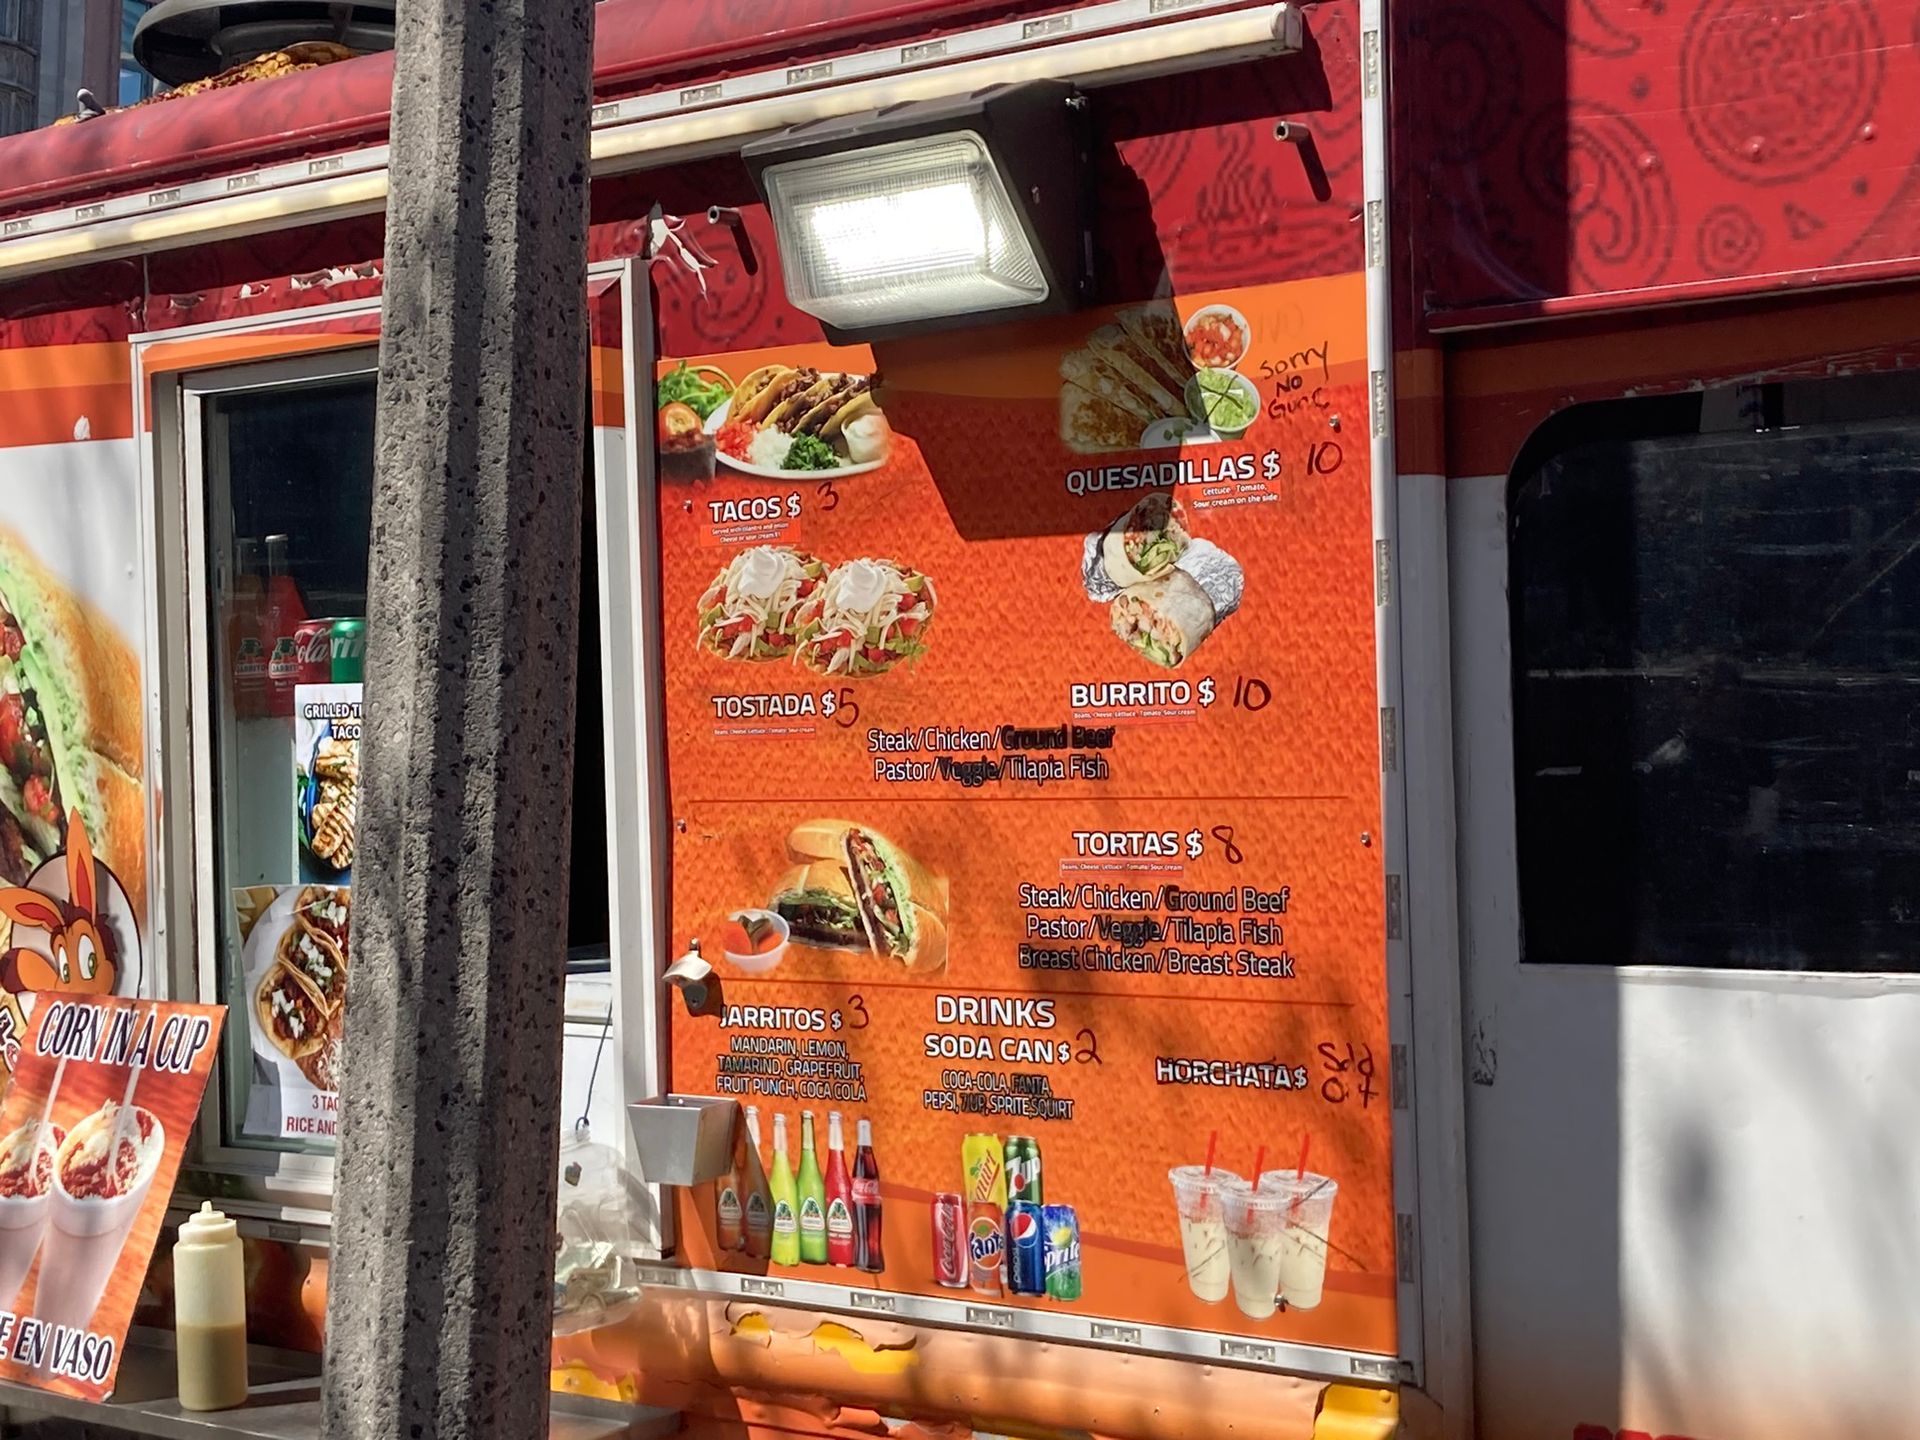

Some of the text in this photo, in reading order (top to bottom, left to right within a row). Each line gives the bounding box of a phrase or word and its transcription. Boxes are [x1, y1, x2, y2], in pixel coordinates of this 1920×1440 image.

[1260, 341, 1330, 382] Sorry
[1276, 374, 1303, 398] NO
[1065, 442, 1344, 497] QUESADILLAS $ 10
[708, 481, 839, 523] TACOS $ 3
[1211, 497, 1236, 507] cream
[1236, 496, 1247, 504] on
[1247, 494, 1262, 503] the
[1262, 492, 1279, 501] side
[711, 688, 860, 728] TOSTADA $ 5
[1070, 675, 1272, 711] BURRITO $ 10
[304, 702, 351, 720] GRILLED
[330, 724, 361, 741] TACO
[1068, 752, 1109, 780] Fish
[1072, 825, 1243, 864] TORTAS $ 8
[1018, 882, 1291, 913] Steak/Chicken/Ground Beef
[1026, 913, 1284, 951] Pastor/Veggie/Tilapia Fish
[1018, 943, 1296, 979] Breast Chicken/Breast Steak
[719, 994, 870, 1033] JARRITOS $ 3
[935, 994, 1057, 1030] DRINKS
[37, 1001, 109, 1063] CORN
[100, 1008, 140, 1065] IN
[130, 1010, 157, 1069] A
[154, 1013, 212, 1074] CUP
[730, 1035, 850, 1061] MANDARIN, LEMON,
[924, 1028, 1103, 1065] SODA CAN $ 2
[717, 1055, 865, 1083] TAMARIND, GRAPEFRUIT,
[941, 1069, 1011, 1093] COCA-COLA,
[312, 1094, 319, 1110] 3
[715, 1075, 868, 1102] FRUIT PUNCH, COCA COLA
[923, 1089, 960, 1113] PEPSI,
[1321, 1076, 1379, 1109] Ot
[286, 1116, 315, 1133] RICE
[1044, 1241, 1080, 1272] prite
[11, 1316, 53, 1368] EN
[50, 1324, 115, 1385] VASO
